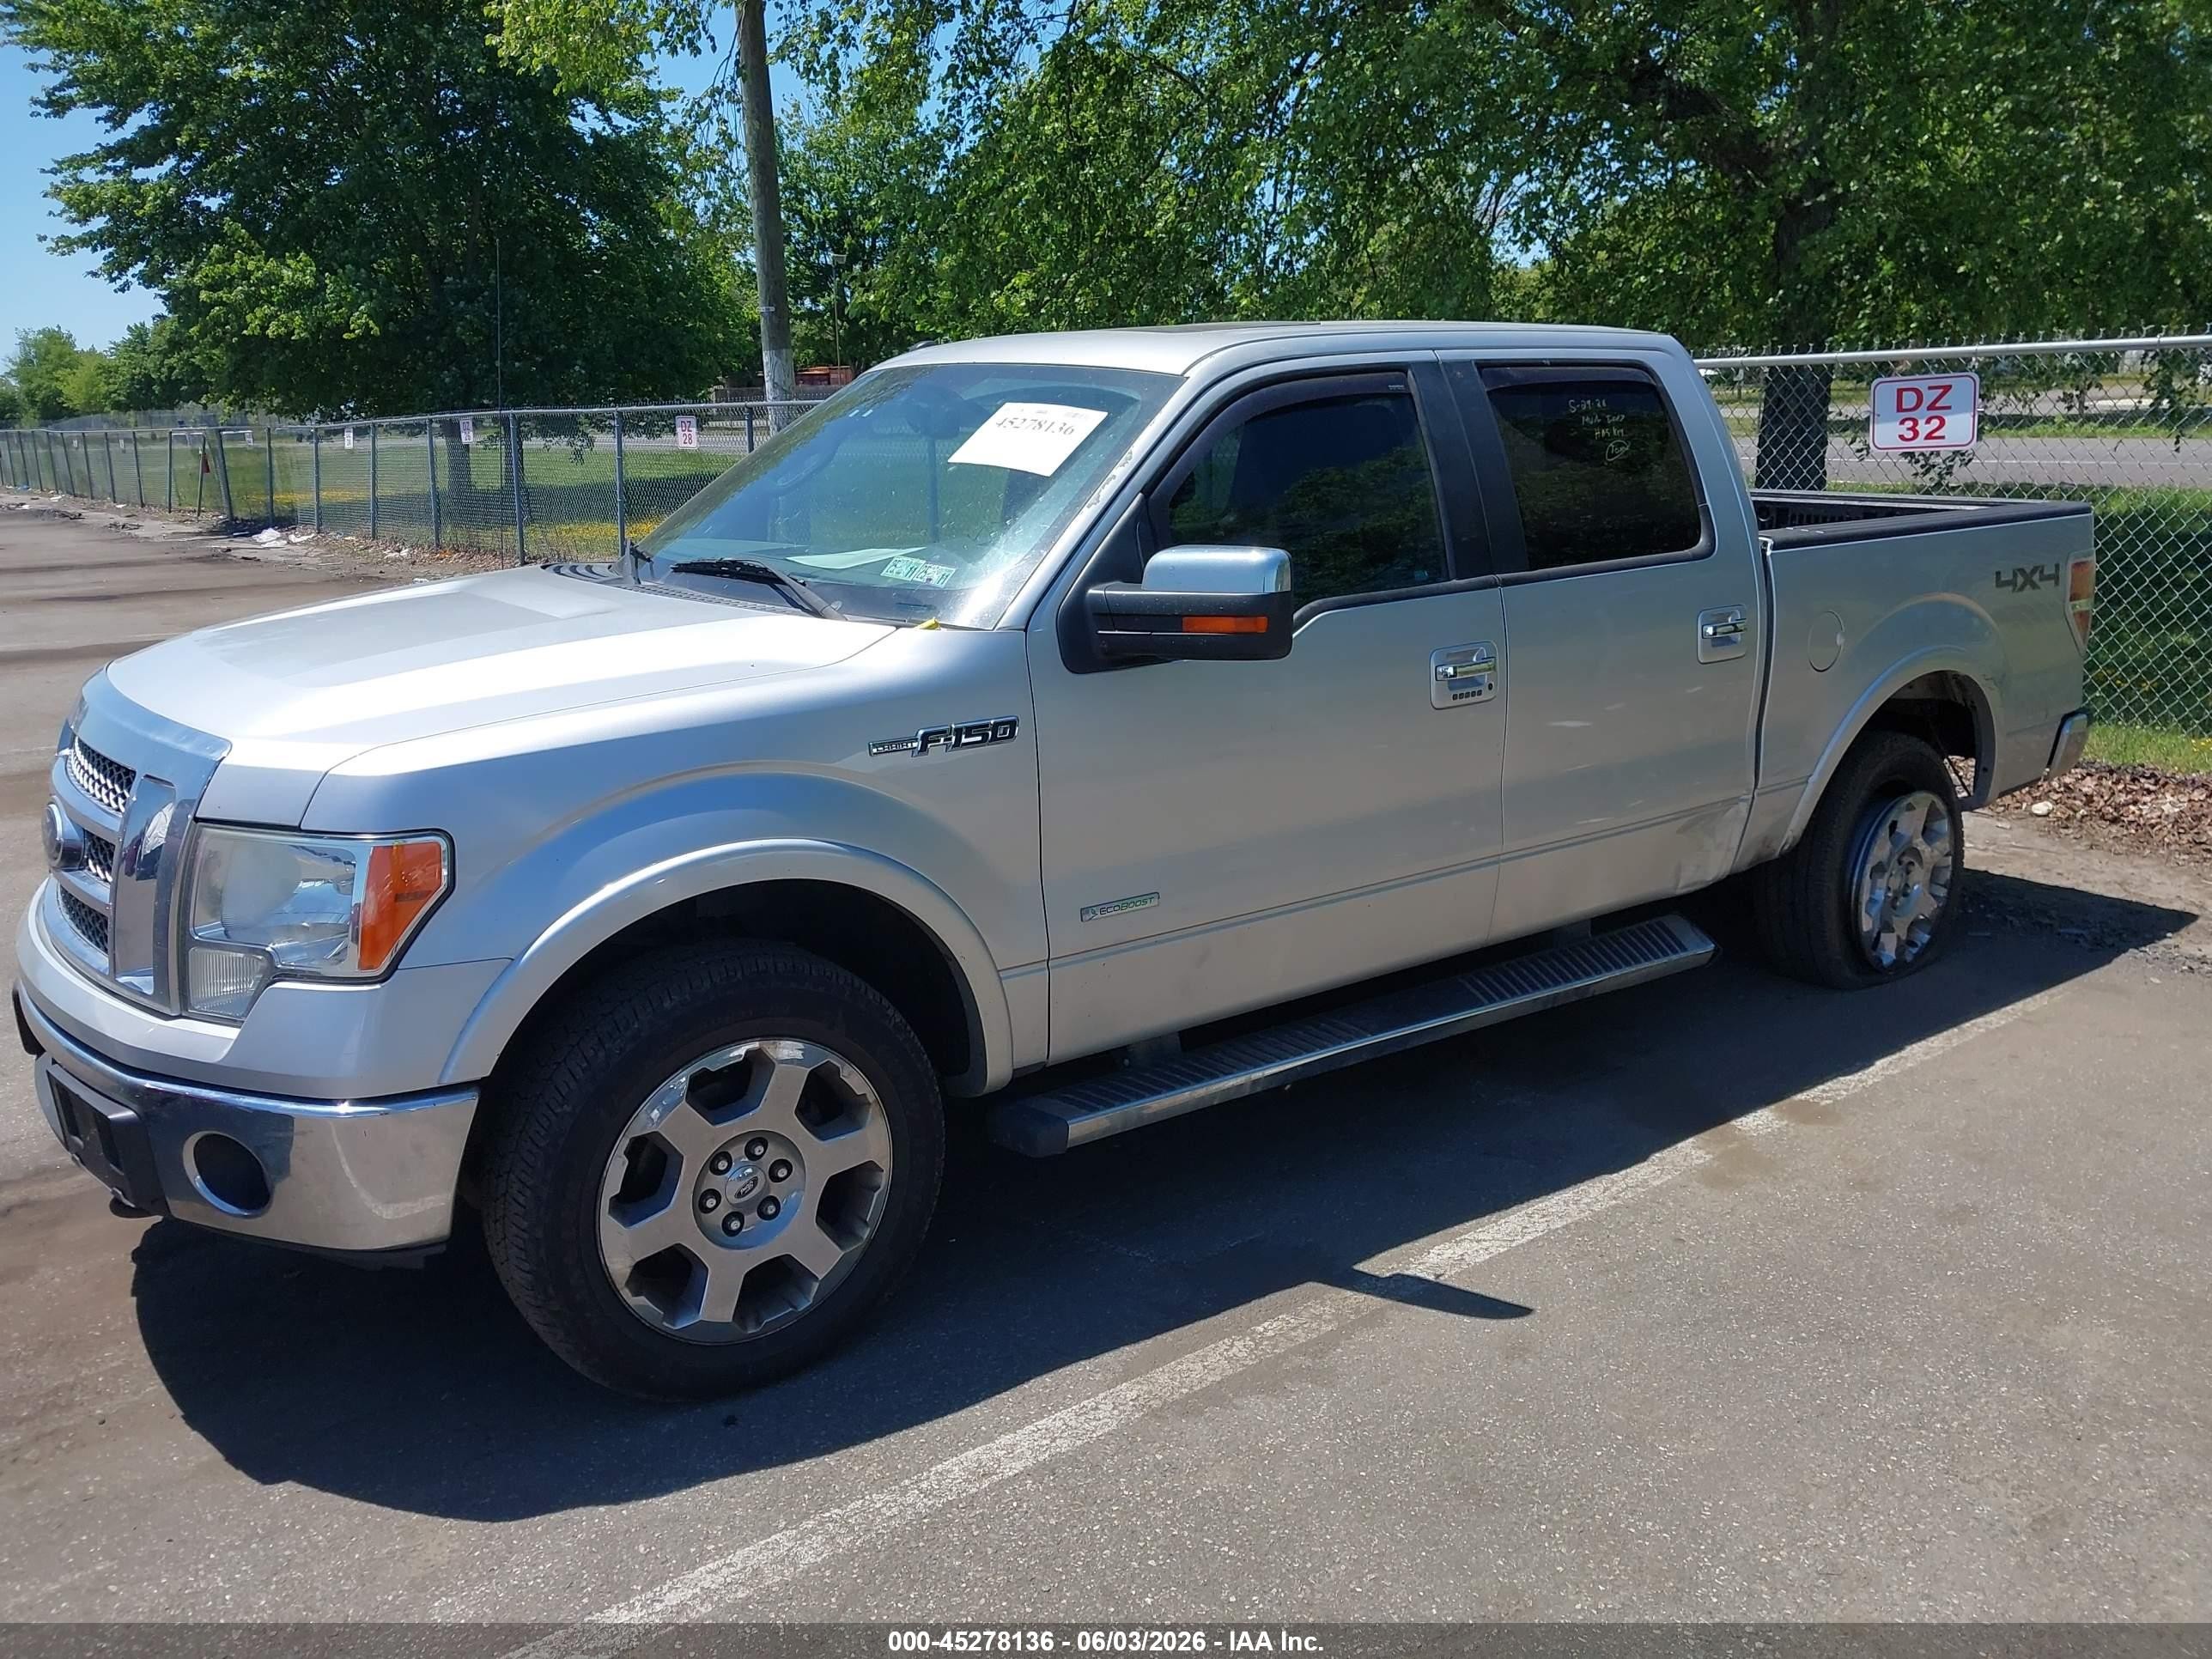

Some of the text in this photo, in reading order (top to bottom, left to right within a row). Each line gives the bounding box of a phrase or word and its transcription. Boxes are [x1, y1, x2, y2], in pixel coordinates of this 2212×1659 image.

[1896, 385, 1953, 413] DZ
[680, 421, 693, 432] DZ
[1898, 415, 1946, 442] 32
[683, 433, 693, 445] 28
[1100, 896, 1155, 915] ECOBOOST
